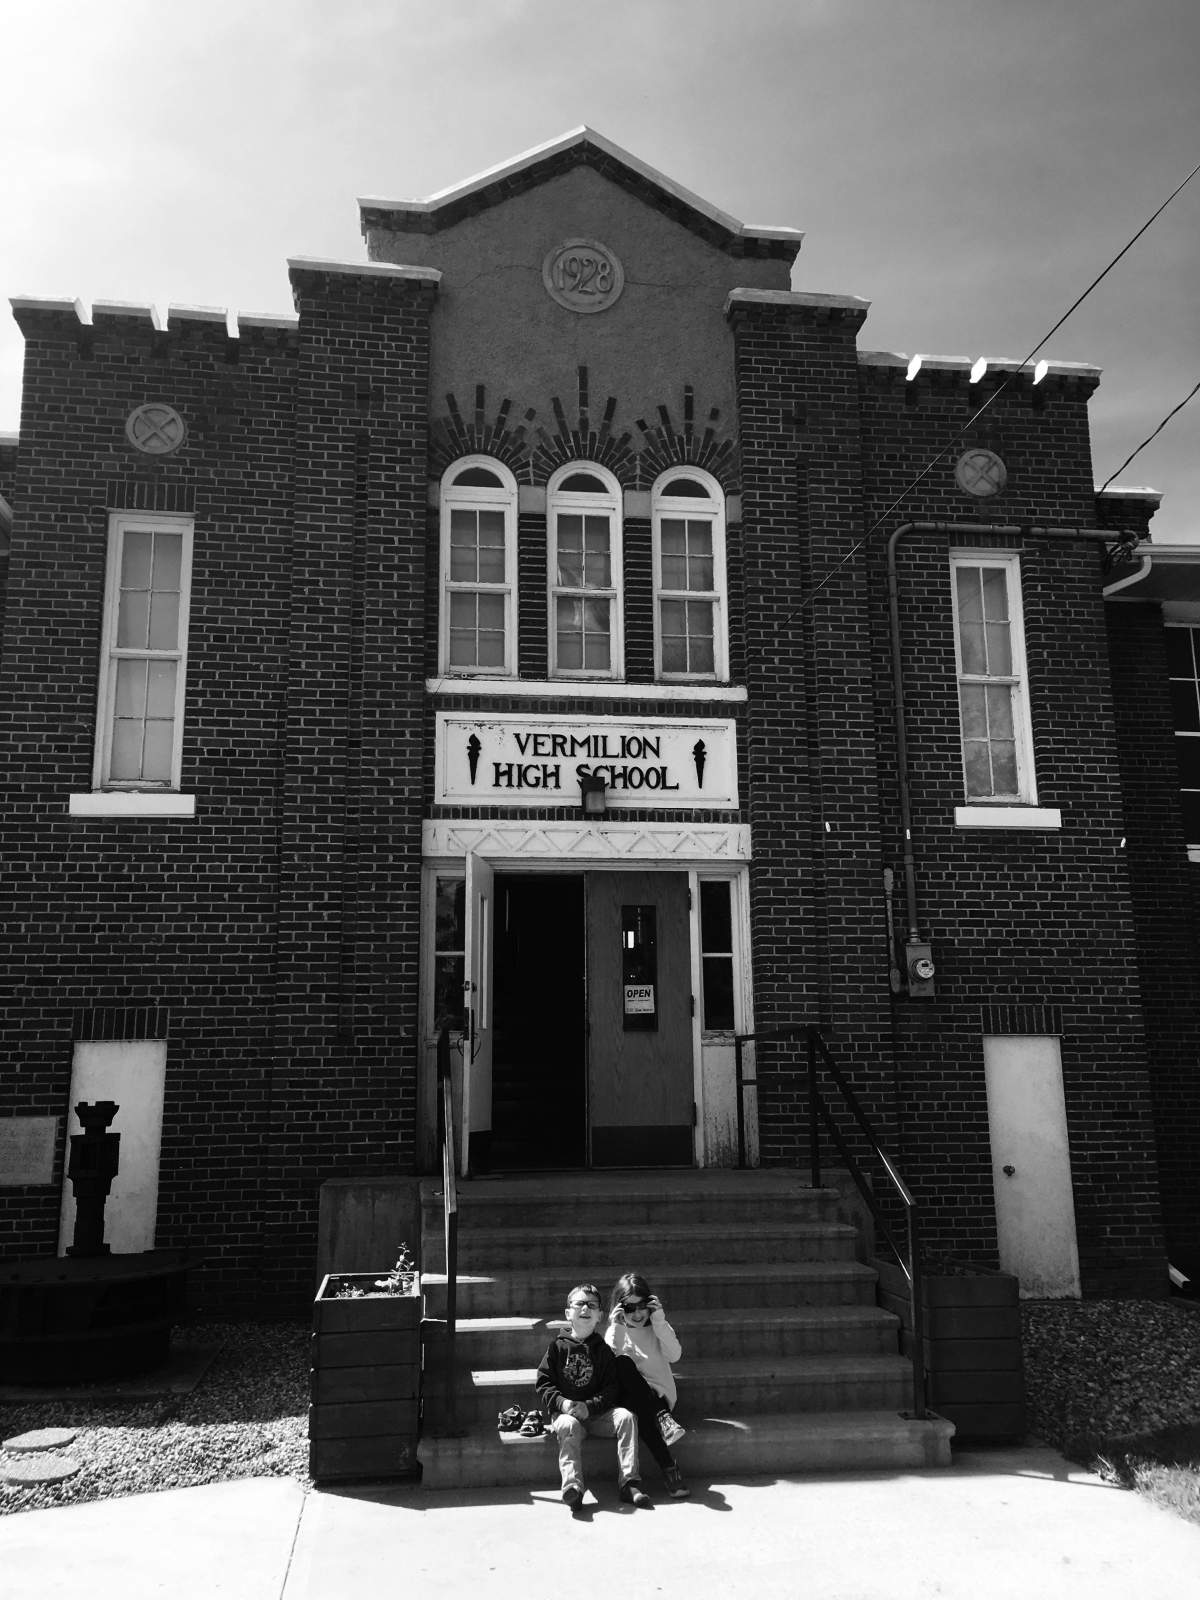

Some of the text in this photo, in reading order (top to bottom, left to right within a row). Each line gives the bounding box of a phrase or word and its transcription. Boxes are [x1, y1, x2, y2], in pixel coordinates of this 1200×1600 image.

[557, 257, 612, 295] 1928
[513, 733, 661, 759] VERMILION
[492, 762, 561, 788] HIGH
[627, 989, 651, 998] OPEN
